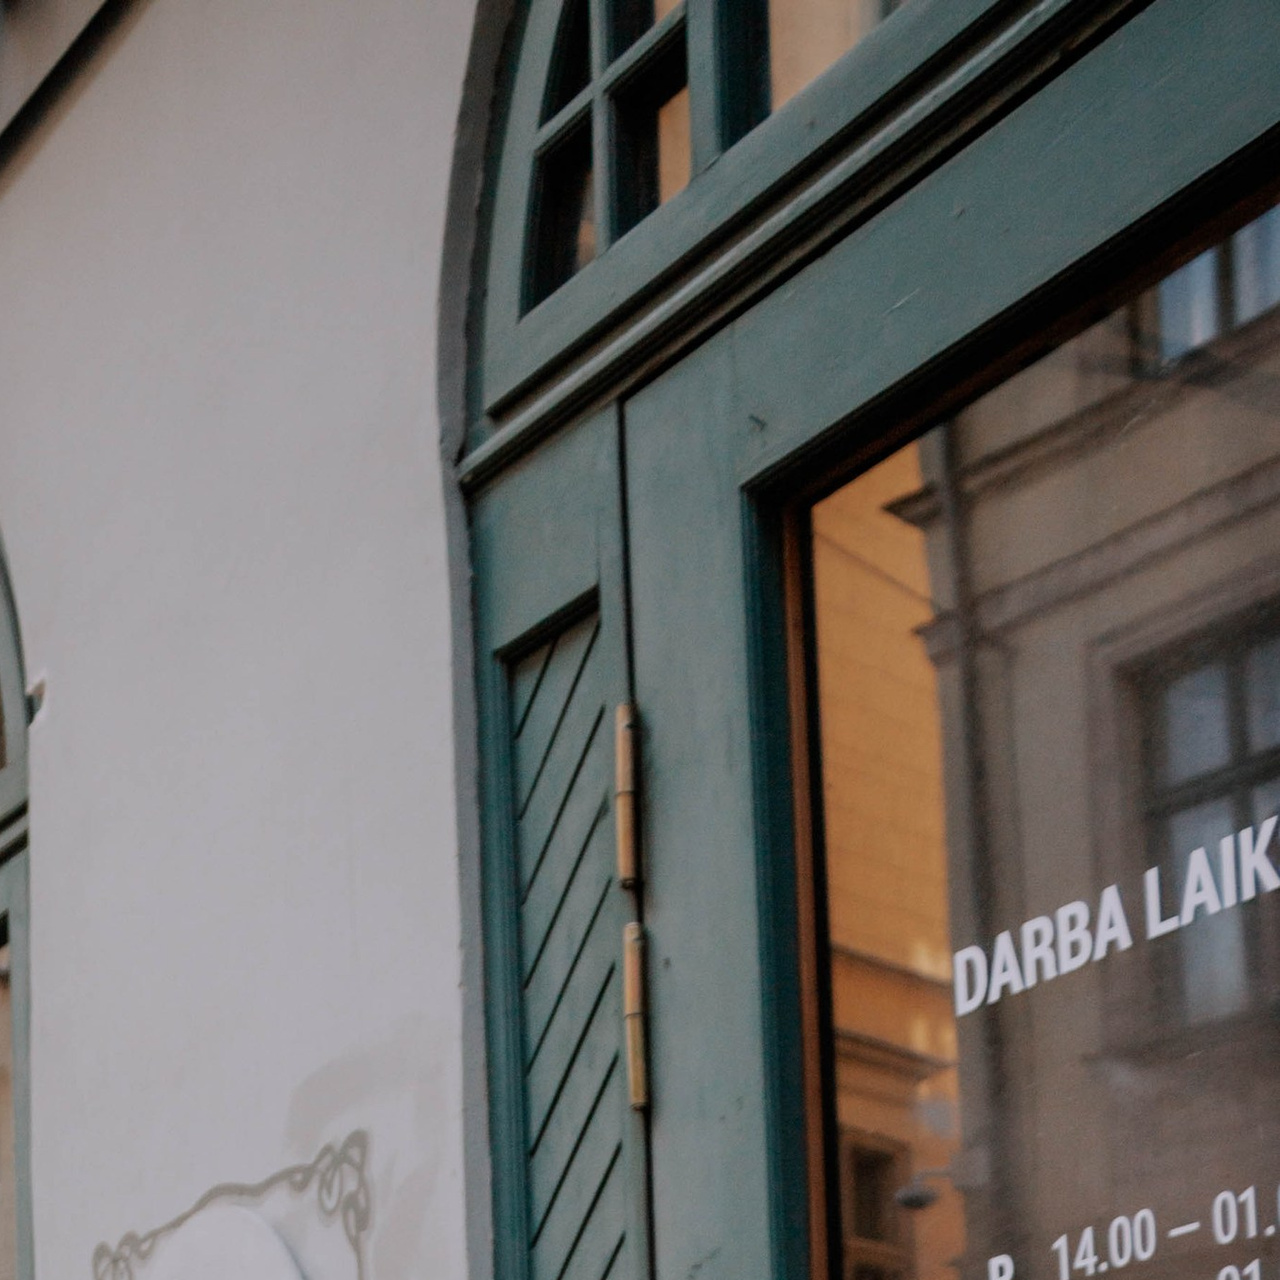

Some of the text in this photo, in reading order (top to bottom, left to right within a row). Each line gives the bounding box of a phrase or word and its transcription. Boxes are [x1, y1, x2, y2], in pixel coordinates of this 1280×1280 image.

[953, 814, 1280, 1017] DARBA LAIK
[1212, 1185, 1280, 1245] 01.
